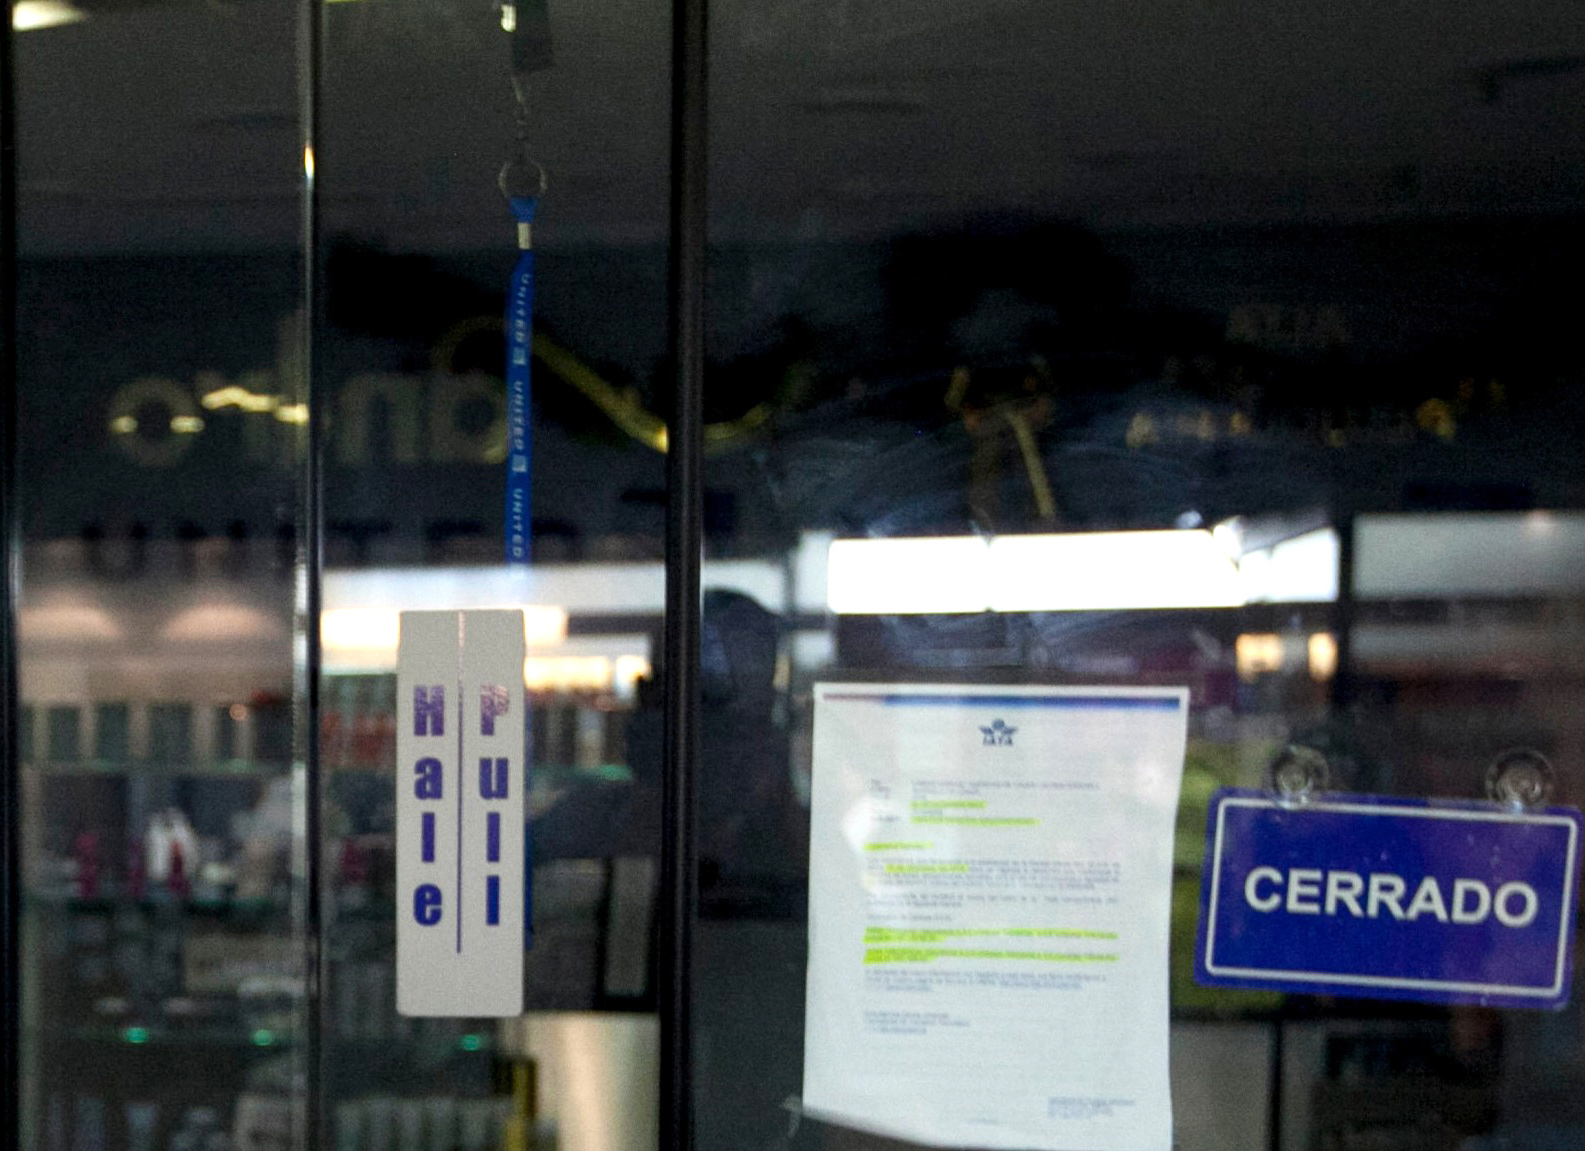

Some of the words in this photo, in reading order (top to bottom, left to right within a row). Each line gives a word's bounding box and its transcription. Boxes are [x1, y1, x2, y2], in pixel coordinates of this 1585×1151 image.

[513, 380, 526, 451] UNITED
[512, 487, 524, 559] UNITED
[414, 685, 445, 927] Hale
[479, 685, 510, 927] Pull
[1244, 865, 1539, 928] CERRADO
